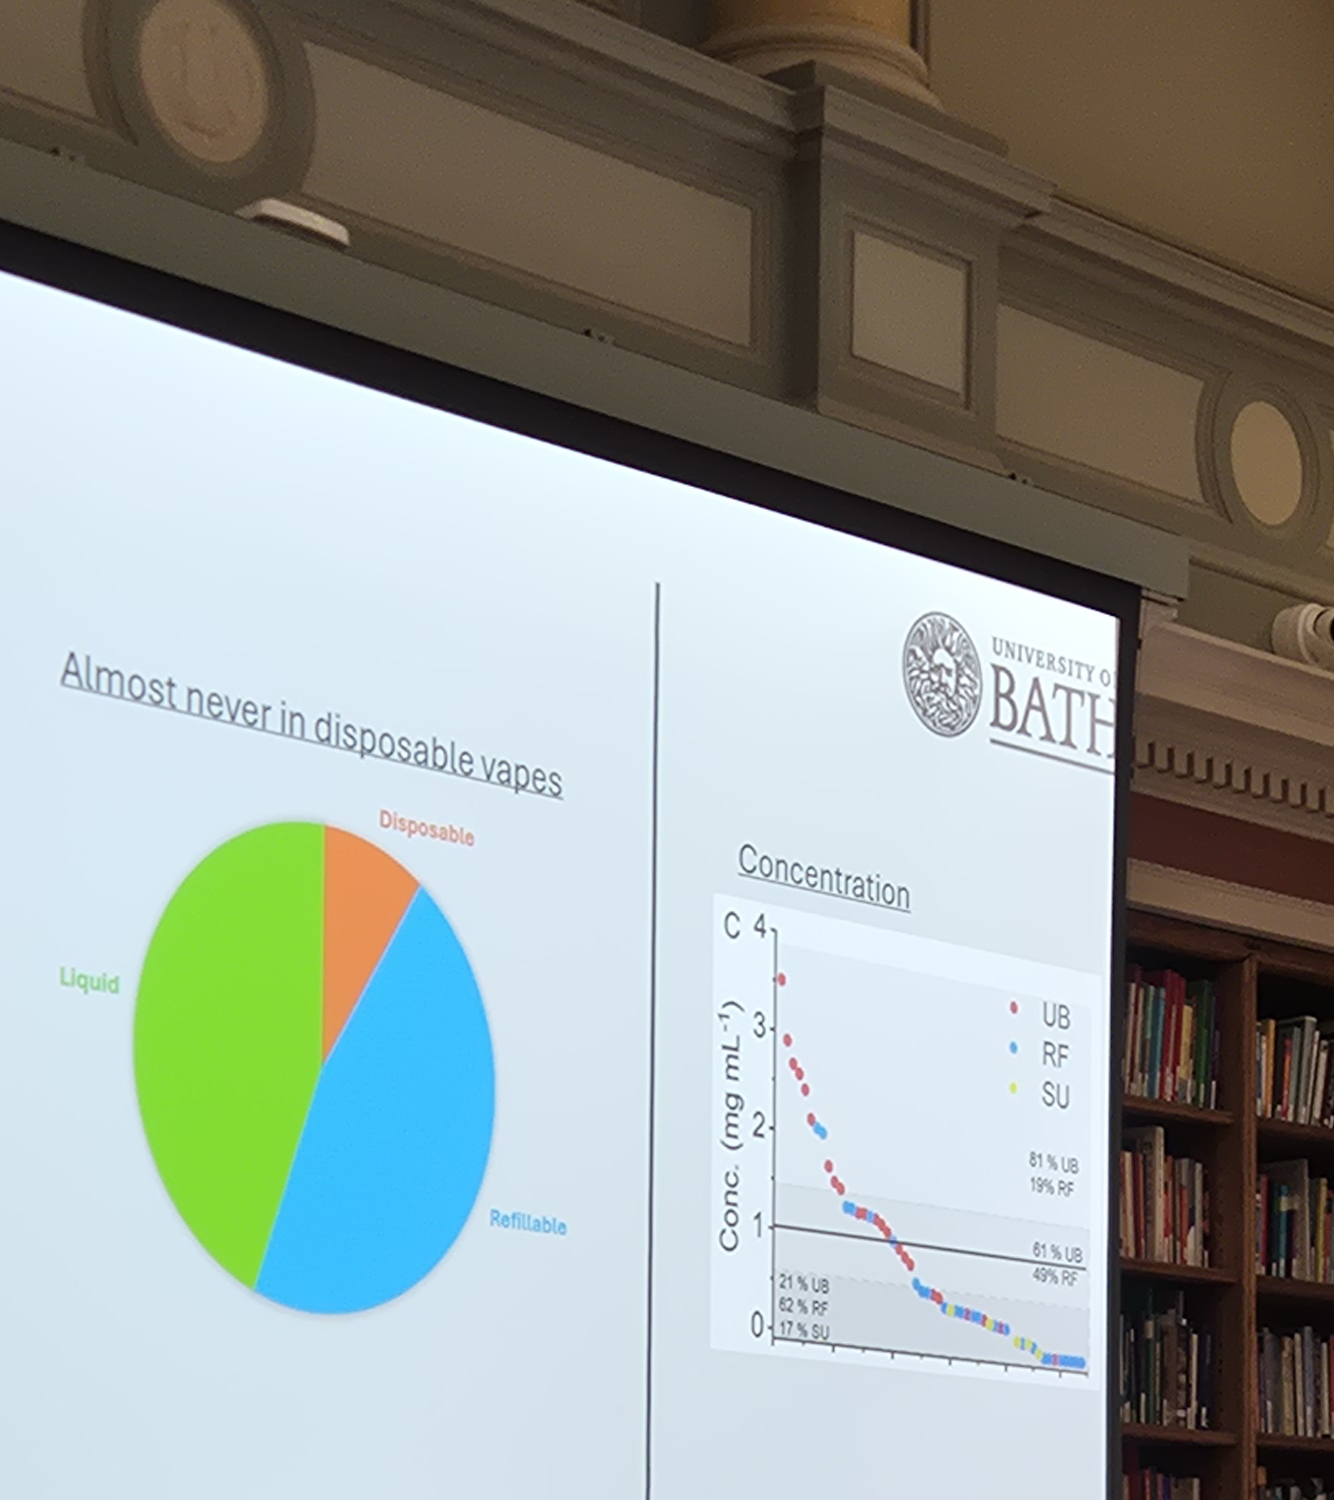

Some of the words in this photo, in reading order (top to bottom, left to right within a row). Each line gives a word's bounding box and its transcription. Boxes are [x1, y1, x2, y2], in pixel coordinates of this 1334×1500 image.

[991, 636, 1095, 685] UNIVERSITY
[60, 651, 177, 710] Almost
[186, 682, 272, 732] never
[280, 700, 306, 739] in
[314, 711, 475, 778] disposable
[481, 754, 564, 799] vapes
[379, 809, 475, 848] Disposable
[738, 844, 911, 909] Concentration
[723, 911, 742, 940] C
[753, 913, 767, 939] 4
[59, 966, 121, 996] Liquid
[753, 1011, 766, 1039] 3
[1042, 1001, 1071, 1030] UB
[1042, 1041, 1070, 1069] RF
[1042, 1081, 1071, 1109] SU
[720, 1092, 745, 1151] (mg
[752, 1111, 766, 1139] 2
[489, 1208, 568, 1236] Refillable
[719, 1164, 740, 1252] Conc.
[753, 1212, 763, 1238] 1
[779, 1273, 793, 1290] 21
[797, 1275, 809, 1292] %
[812, 1277, 830, 1294] UB
[778, 1296, 795, 1313] 62
[797, 1298, 809, 1315] %
[812, 1300, 829, 1317] RF
[751, 1310, 764, 1339] 0
[780, 1320, 794, 1336] 17
[796, 1322, 809, 1338] %
[811, 1323, 830, 1341] SU
